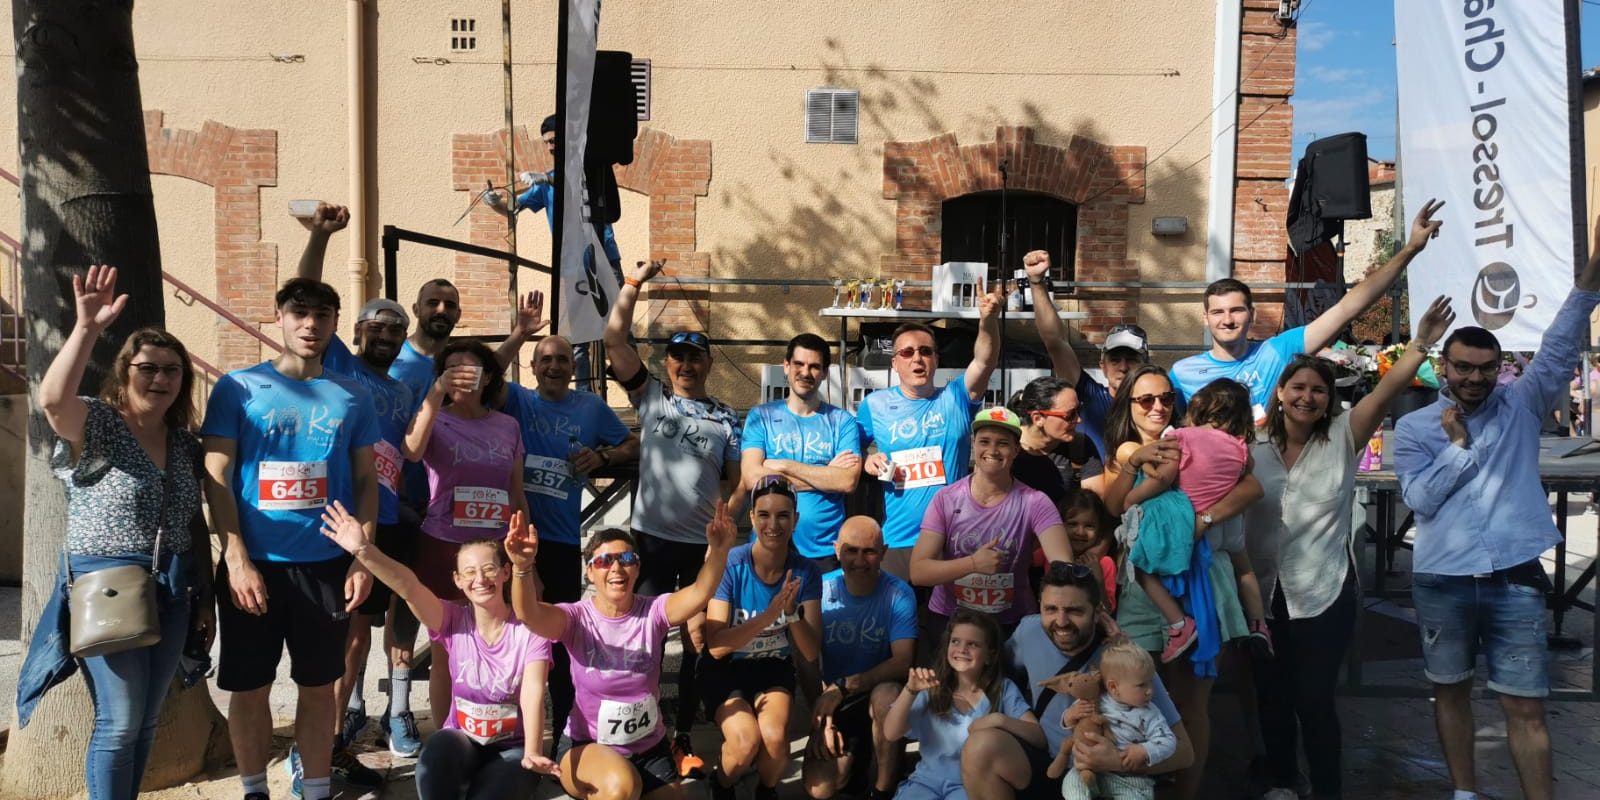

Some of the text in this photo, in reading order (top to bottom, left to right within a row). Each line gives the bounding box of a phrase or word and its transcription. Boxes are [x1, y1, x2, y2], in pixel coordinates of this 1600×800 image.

[261, 405, 302, 437] 10
[652, 415, 708, 449] 10 Km
[888, 416, 918, 445] 10
[773, 431, 832, 456] 10 Km
[374, 455, 398, 482] 652
[531, 469, 567, 489] 357
[271, 480, 318, 500] 645
[465, 502, 503, 520] 672
[961, 587, 1007, 606] 912
[826, 616, 886, 644] 10 Km
[464, 716, 503, 737] 611
[608, 711, 651, 736] 764
